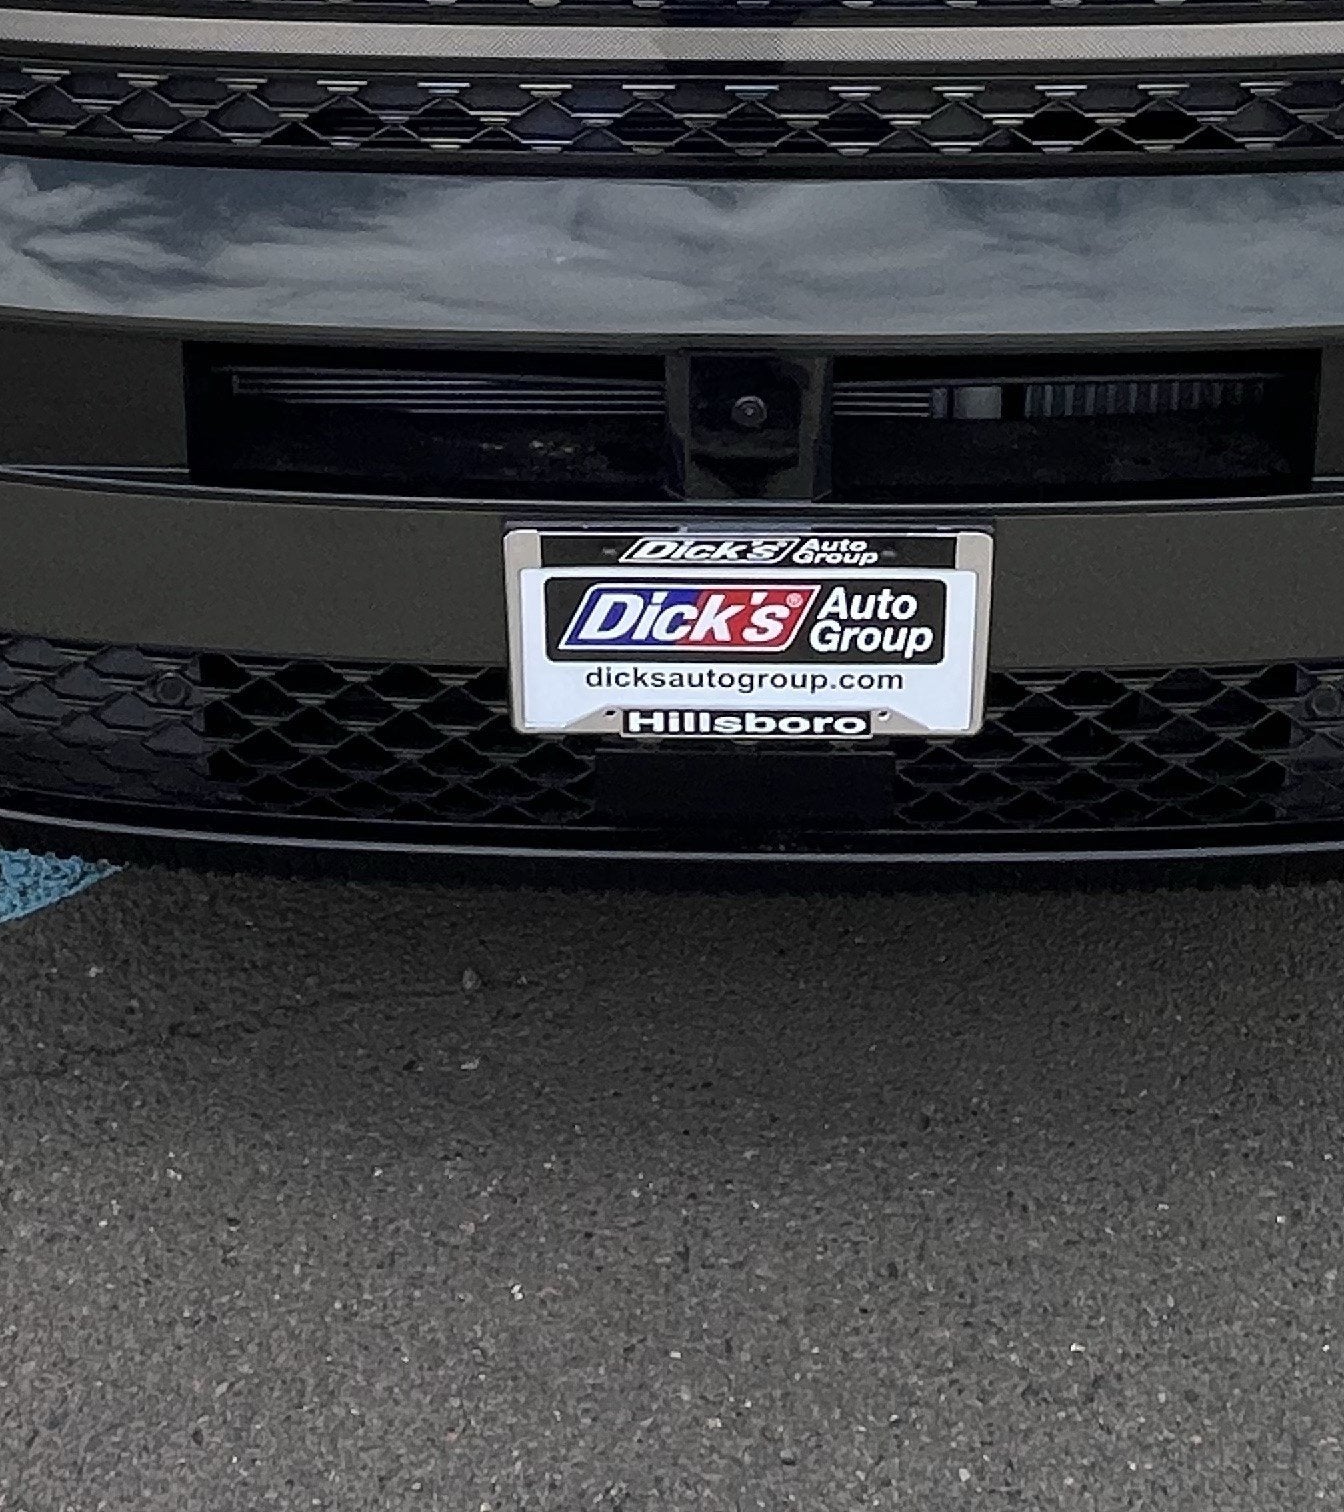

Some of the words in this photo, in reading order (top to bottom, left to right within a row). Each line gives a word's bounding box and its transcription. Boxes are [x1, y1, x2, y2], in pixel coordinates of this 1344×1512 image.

[632, 539, 785, 561] Dick's
[802, 538, 868, 552] Auto
[792, 551, 879, 566] Group
[576, 591, 792, 642] Dick's
[817, 586, 919, 620] Auto
[809, 618, 934, 658] Group
[585, 666, 905, 694] dicksautogroup.com
[627, 710, 868, 736] Hillsboro
